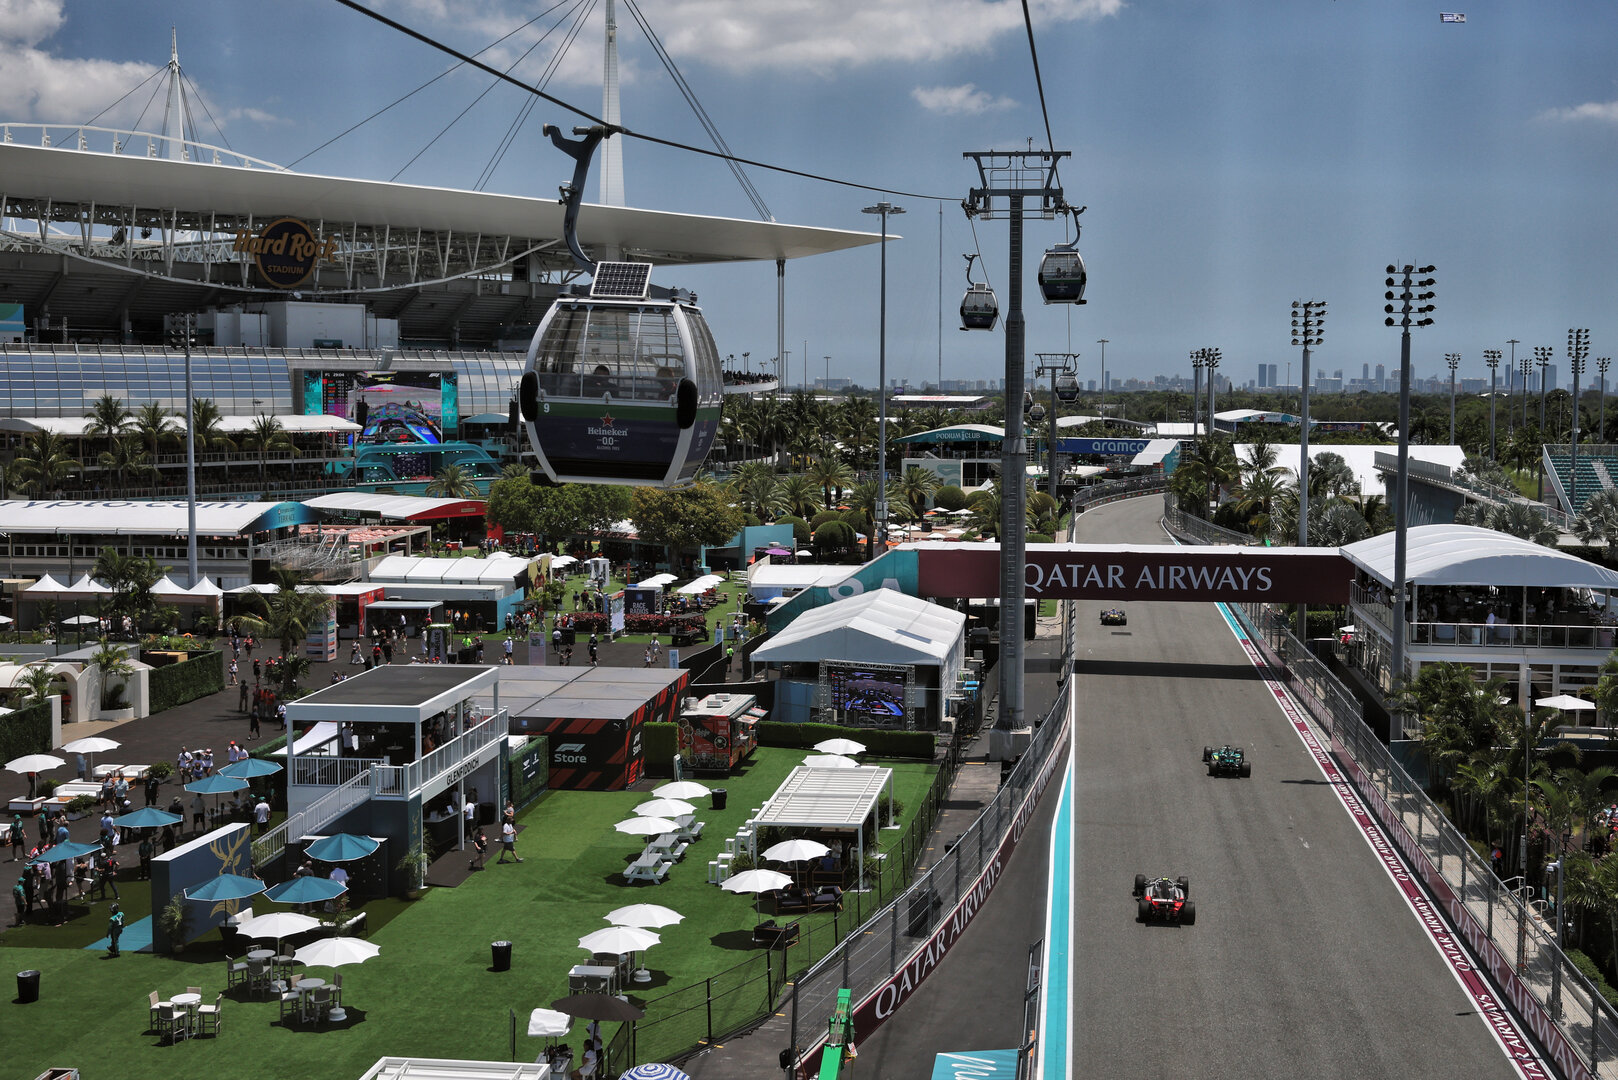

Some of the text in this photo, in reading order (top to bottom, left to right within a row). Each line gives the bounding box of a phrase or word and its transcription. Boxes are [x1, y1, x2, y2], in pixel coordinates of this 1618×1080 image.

[233, 228, 338, 263] Hard Rock
[267, 264, 304, 274] STADIUM
[543, 402, 550, 413] 9
[587, 426, 628, 436] Heineken
[935, 432, 962, 440] PODIUM
[1091, 441, 1146, 452] aramco
[1024, 563, 1273, 592] QATAR AIRWAYS
[446, 757, 480, 786] GLENFIDDICH
[554, 753, 587, 764] Store
[1013, 788, 1037, 843] QATAR
[1365, 826, 1409, 881] QATAR AIRWAYS
[1385, 811, 1429, 882] AIRWAYS
[875, 853, 1002, 1020] QATAR AIRWAYS
[1412, 896, 1471, 972] QATAR AIRWAYS
[1450, 898, 1501, 985] QATAR
[1478, 994, 1526, 1050] AIRWAYS
